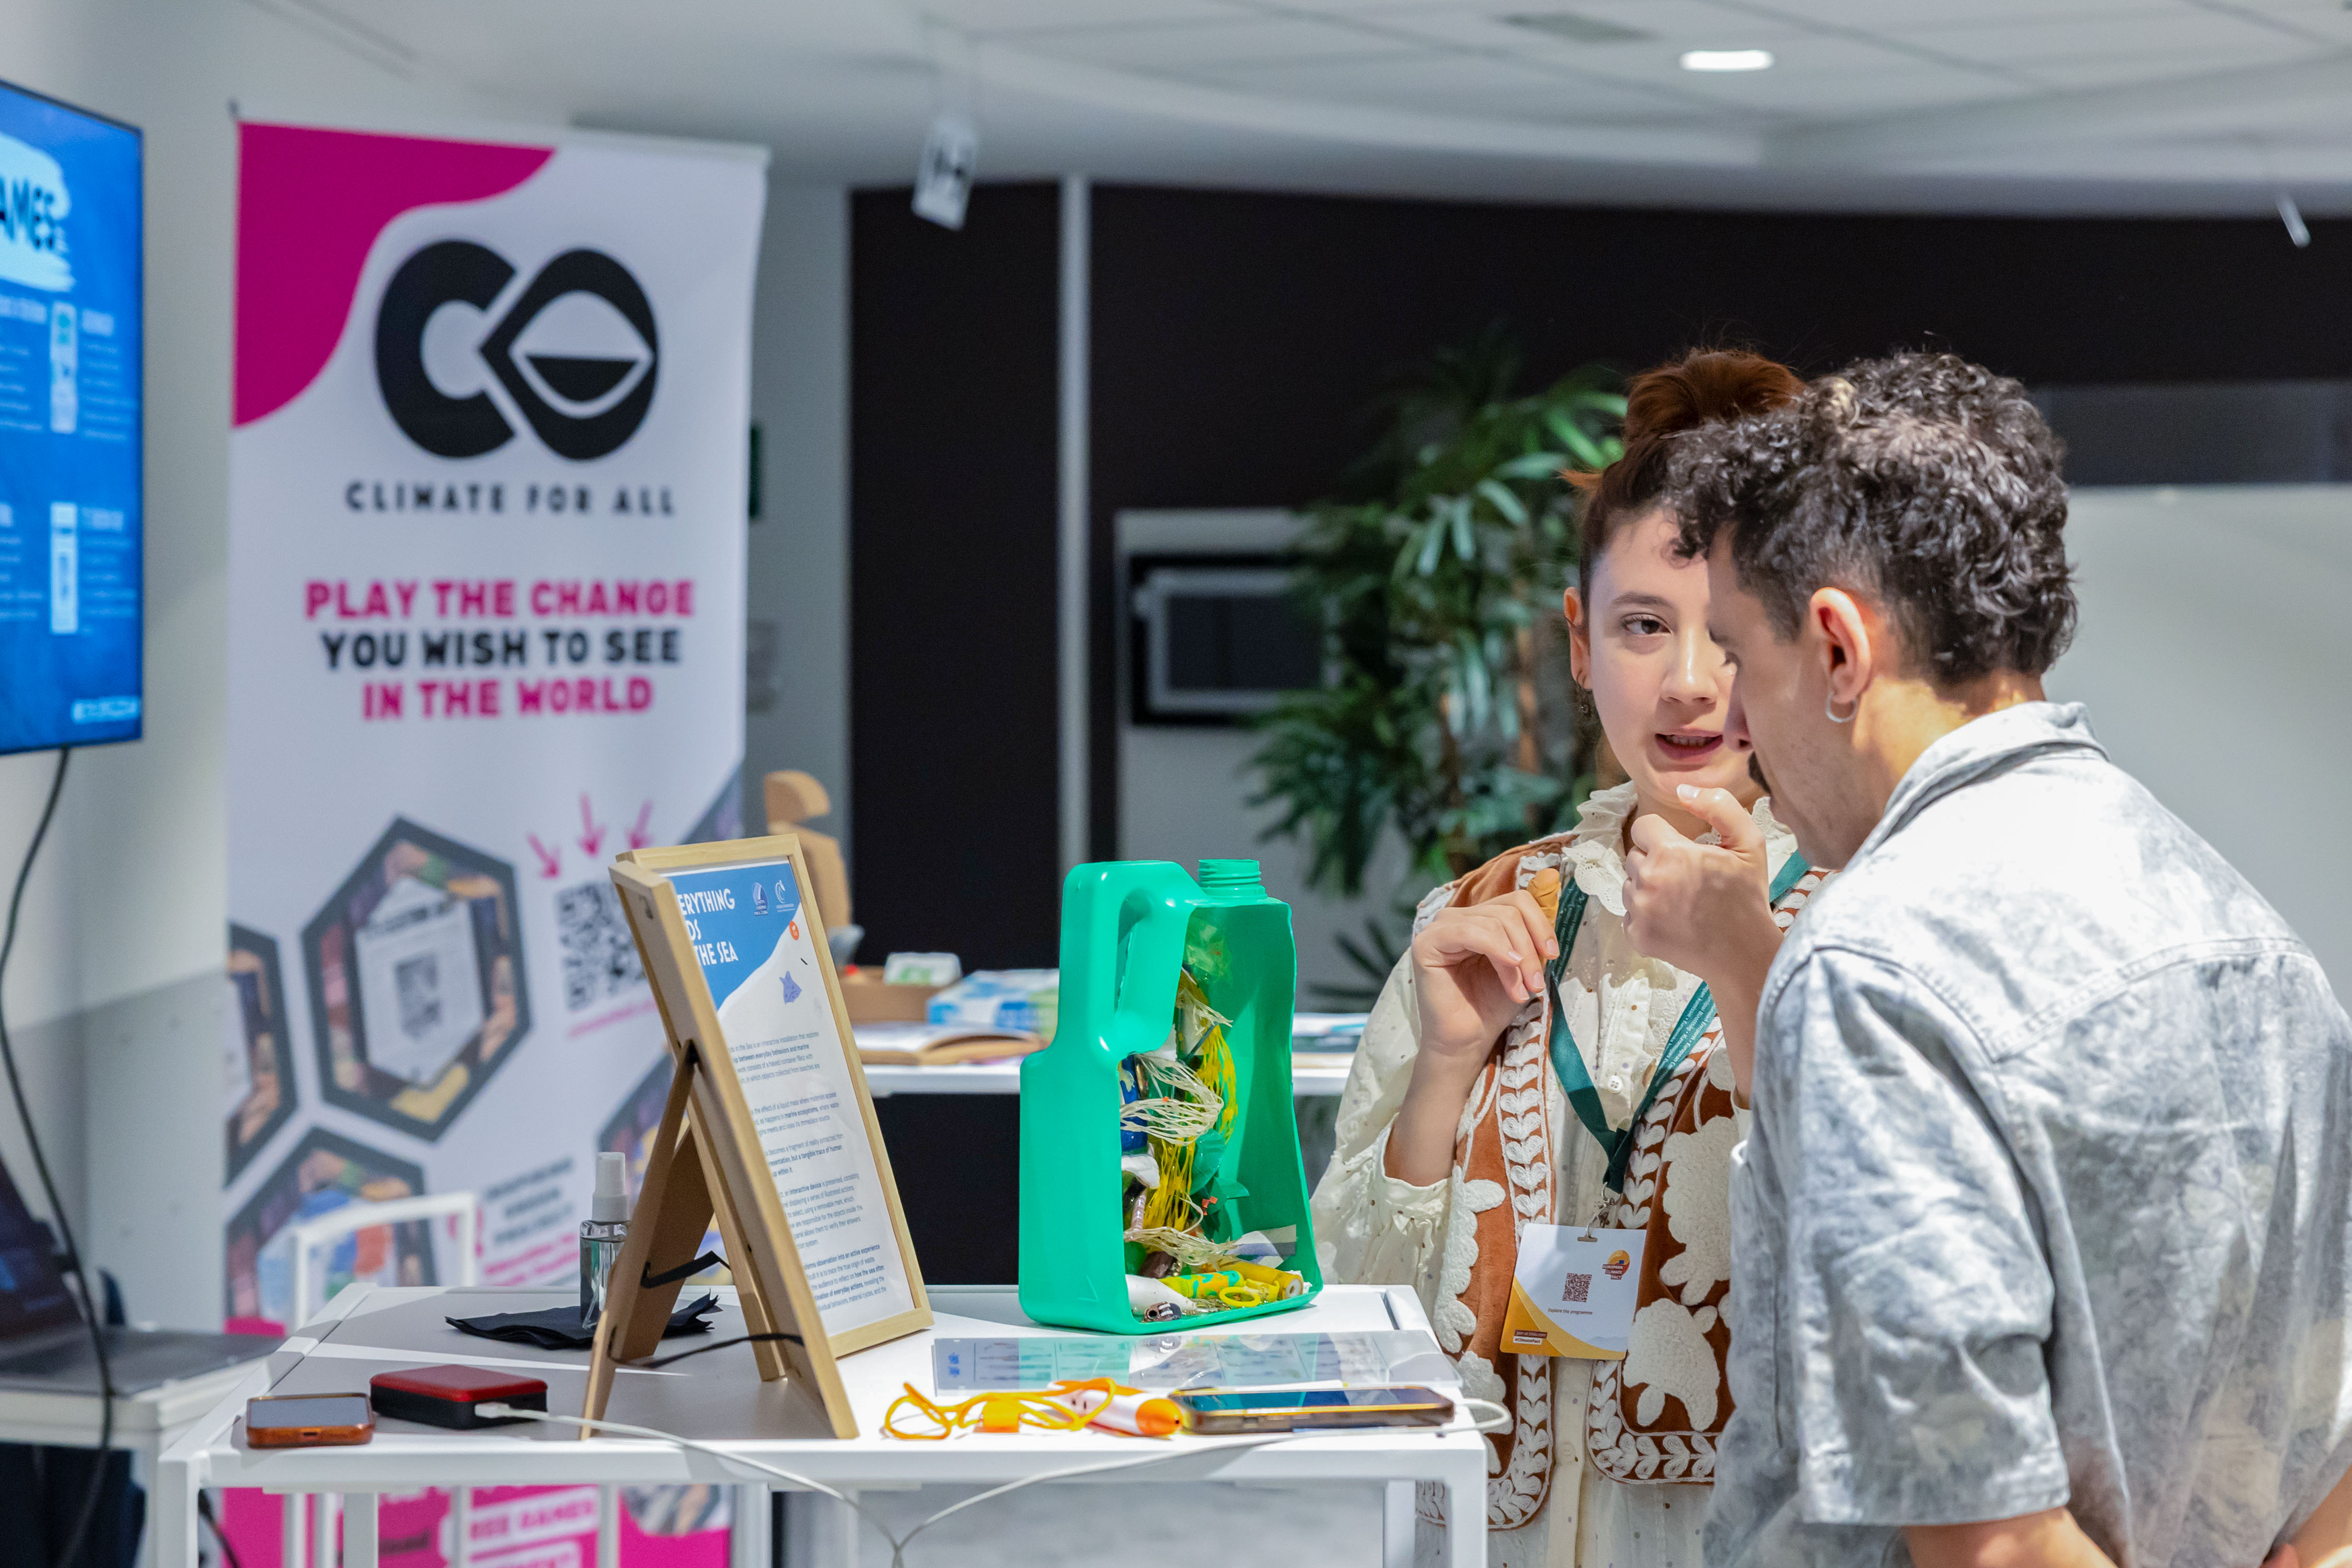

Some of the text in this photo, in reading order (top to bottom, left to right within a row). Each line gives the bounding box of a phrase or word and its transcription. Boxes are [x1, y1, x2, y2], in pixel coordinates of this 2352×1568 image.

[345, 481, 675, 516] CLIMATE FOR ALL
[305, 580, 694, 618] PLAY THE CHANGE
[322, 629, 681, 670] YOU WISH TO SEE
[364, 677, 652, 719] IN THE WORLD
[676, 888, 735, 915] ERYTHING
[685, 919, 701, 940] DS
[693, 941, 739, 965] THE SEA
[1674, 1043, 1690, 1062] European
